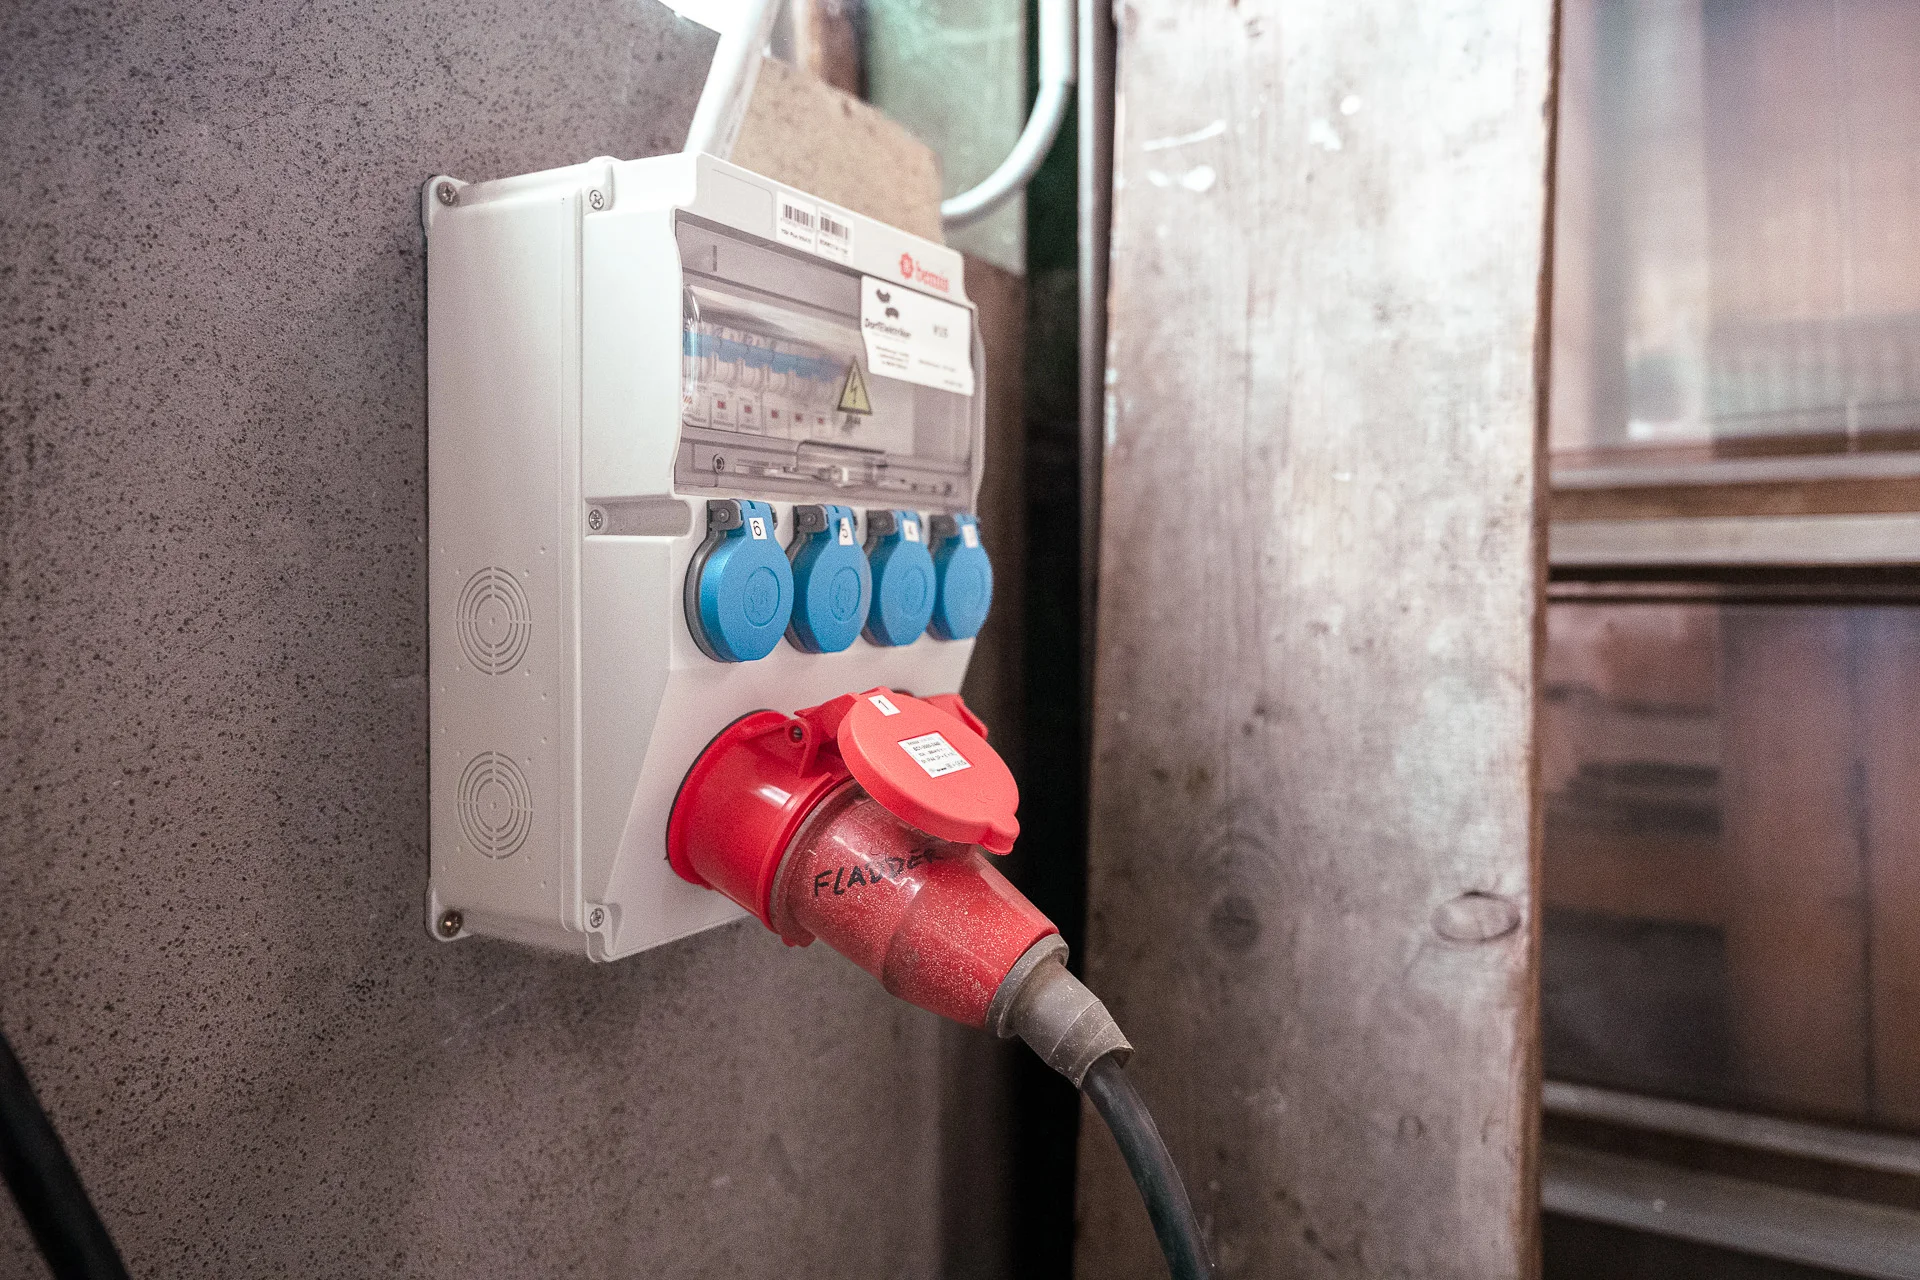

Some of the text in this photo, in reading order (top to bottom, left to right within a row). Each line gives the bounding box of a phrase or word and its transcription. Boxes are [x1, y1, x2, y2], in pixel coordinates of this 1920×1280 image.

[752, 520, 763, 537] 6
[841, 520, 849, 538] 5
[878, 700, 890, 711] 1
